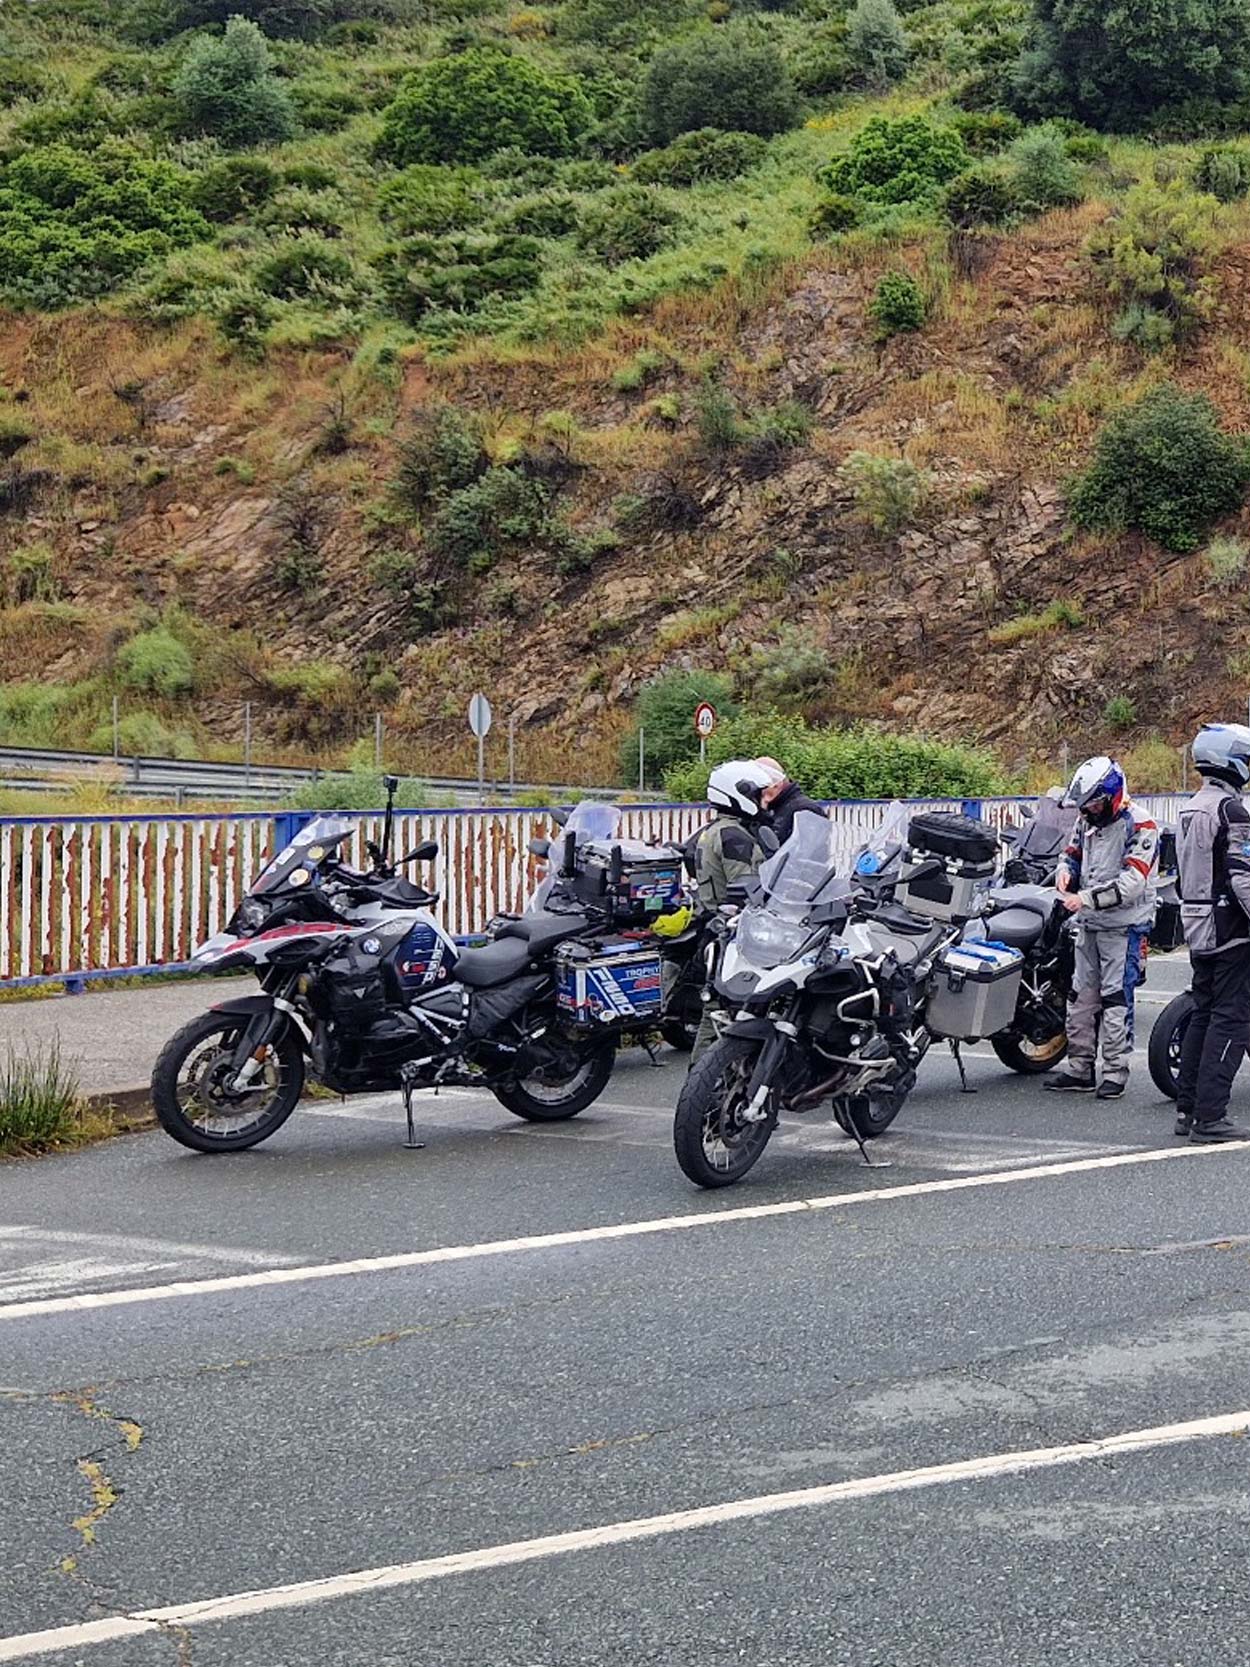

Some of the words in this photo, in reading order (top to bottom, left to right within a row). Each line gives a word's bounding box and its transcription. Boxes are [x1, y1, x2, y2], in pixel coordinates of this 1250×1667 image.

[700, 716, 711, 727] 40
[636, 883, 674, 899] GS
[625, 966, 660, 978] TROPHY
